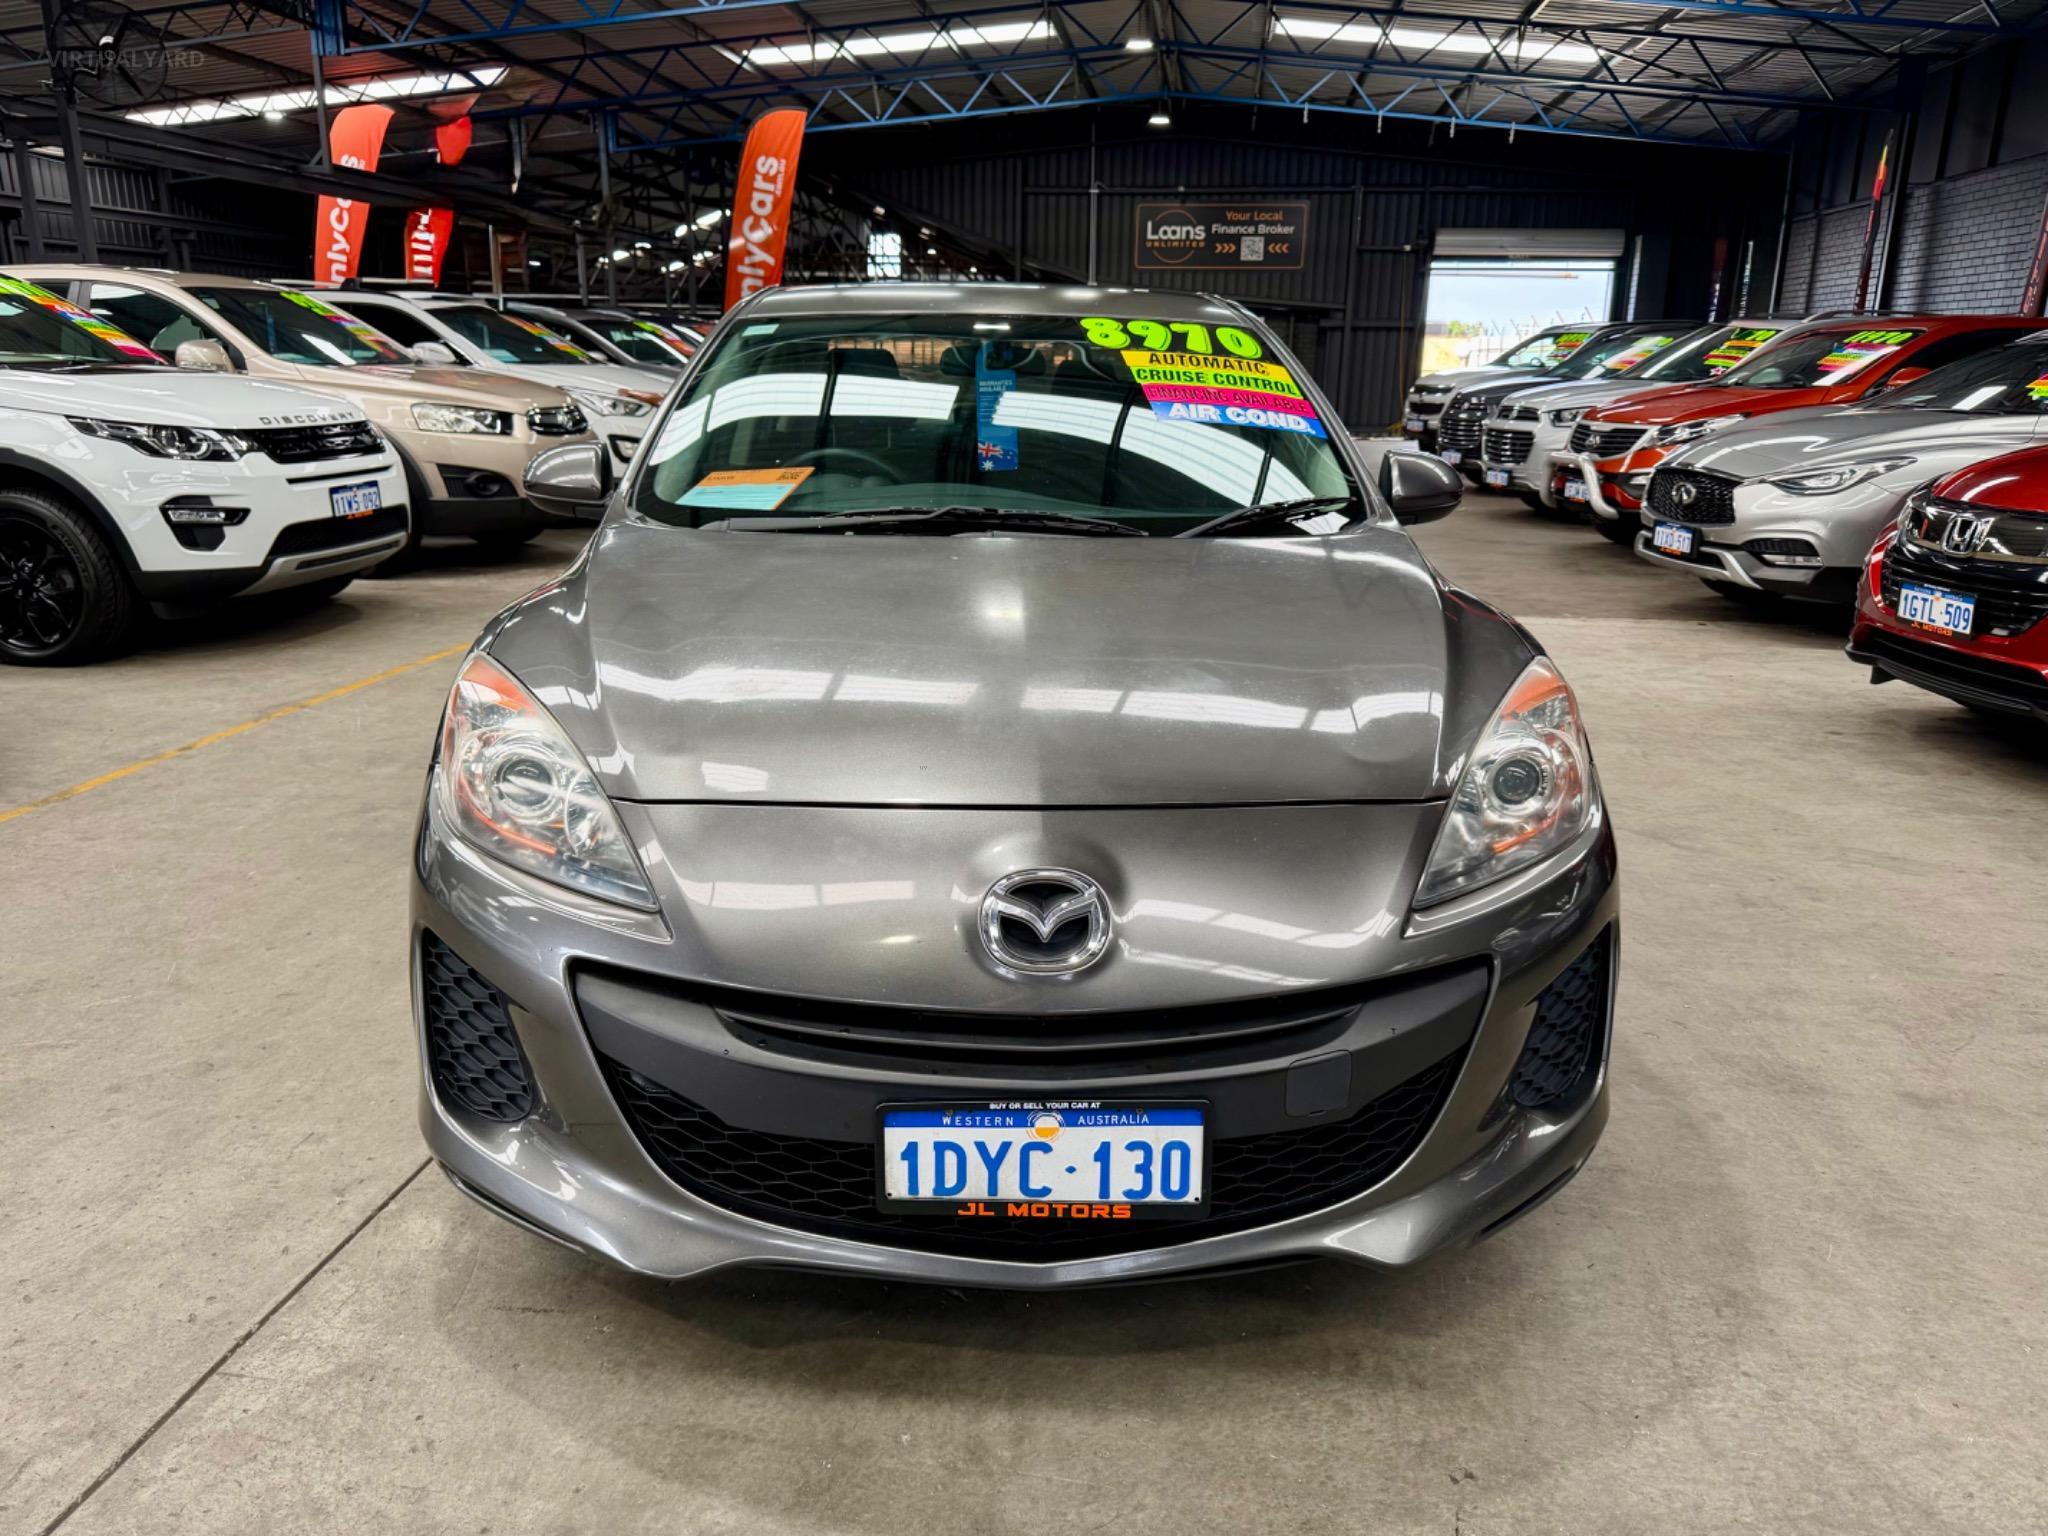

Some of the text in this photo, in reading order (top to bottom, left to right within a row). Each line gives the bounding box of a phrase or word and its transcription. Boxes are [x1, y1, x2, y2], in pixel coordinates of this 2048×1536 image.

[1225, 210, 1284, 221] Your Local
[1146, 220, 1206, 241] Loans
[1211, 223, 1296, 235] Finance Broker
[1079, 317, 1263, 359] 8970
[1148, 352, 1268, 375] AUTOMATIC
[1136, 368, 1300, 395] CRUISE CONTROL
[1148, 383, 1309, 413] FINANCING AVAILABLE
[258, 412, 355, 426] DISCOVERY
[1168, 402, 1317, 434] AIR COND.
[989, 1102, 1007, 1110] BUY
[942, 1114, 1150, 1126] WESTERN AUSTRALIA
[957, 1202, 1132, 1219] JL MOTORS
